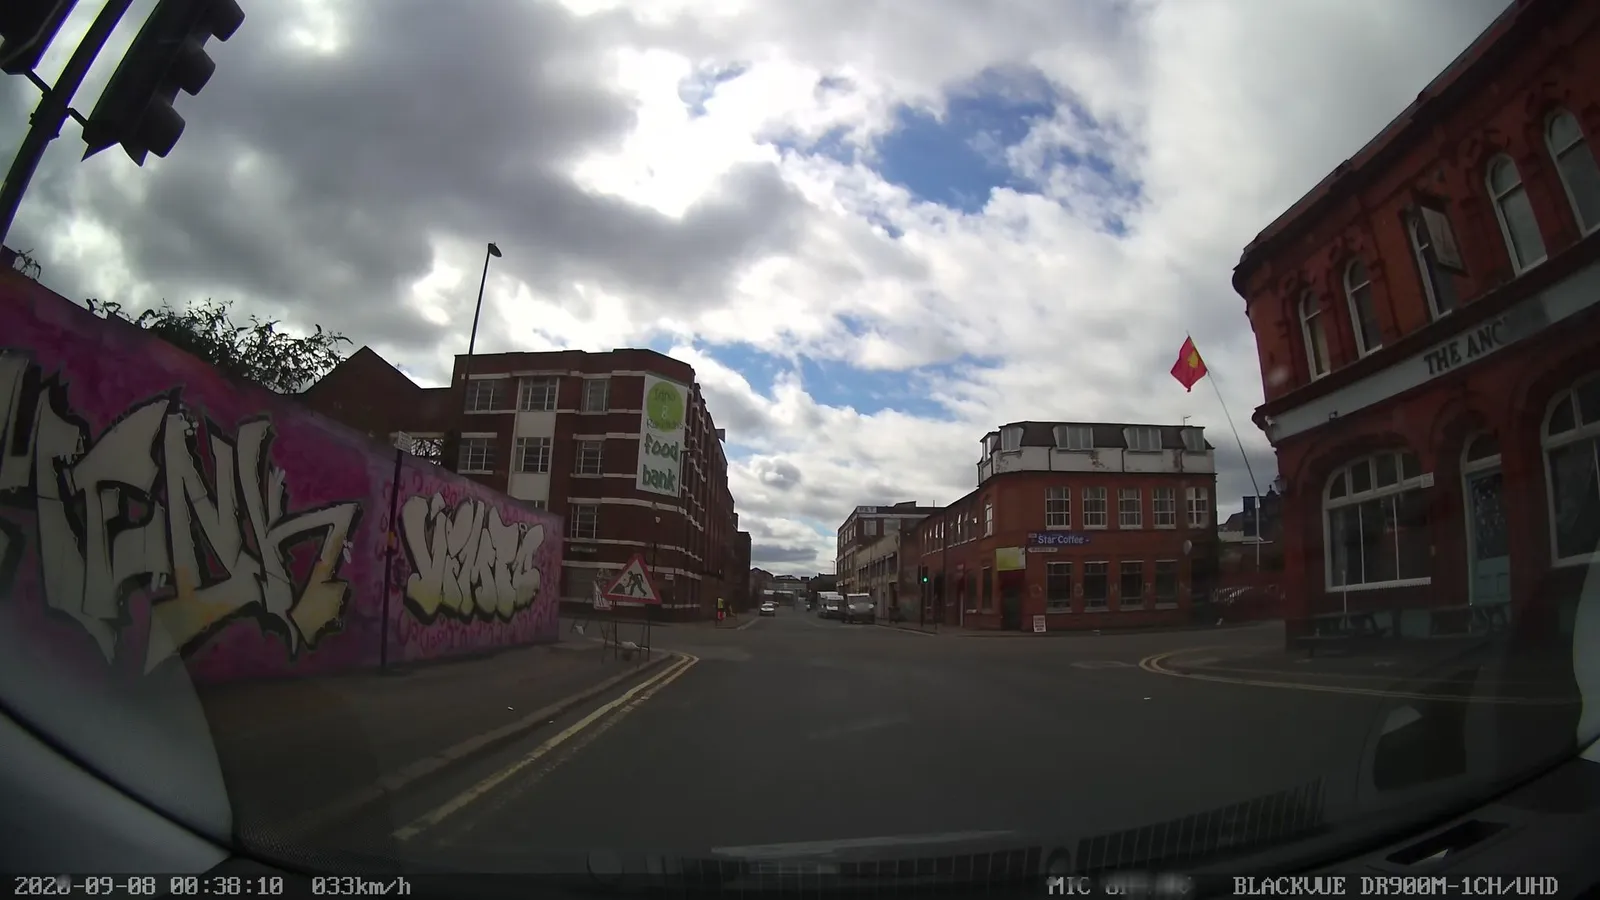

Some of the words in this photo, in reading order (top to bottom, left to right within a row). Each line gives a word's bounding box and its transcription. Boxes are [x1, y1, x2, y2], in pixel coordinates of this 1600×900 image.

[1423, 340, 1462, 375] THE
[1467, 316, 1507, 358] ANC
[644, 432, 679, 462] food
[642, 464, 676, 492] bank
[1038, 535, 1057, 544] Star
[1057, 535, 1084, 544] Coffee
